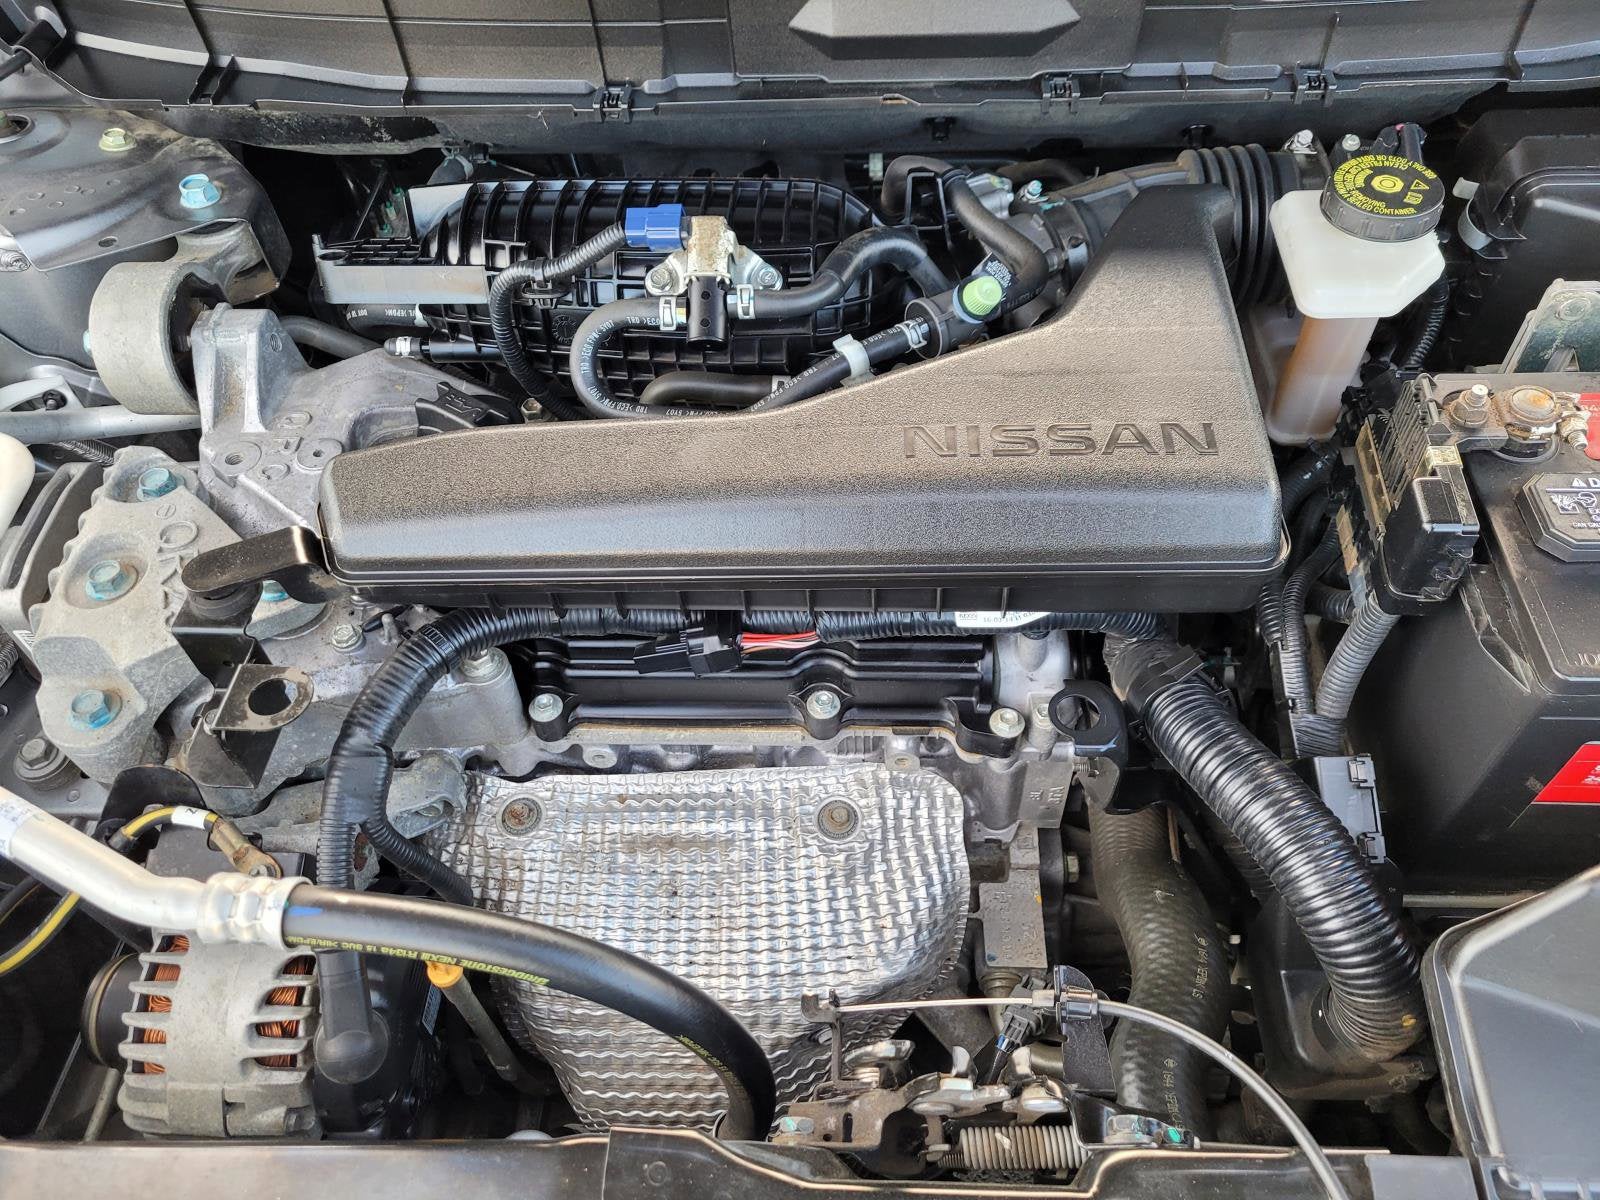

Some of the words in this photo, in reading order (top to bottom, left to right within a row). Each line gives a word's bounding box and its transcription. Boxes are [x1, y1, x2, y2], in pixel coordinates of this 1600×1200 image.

[1383, 160, 1409, 171] CLEAN
[1348, 189, 1386, 208] REMOVING
[1372, 206, 1417, 216] CONTAINER
[902, 421, 1219, 458] NISSAN
[460, 958, 549, 985] BRIDGESTONE
